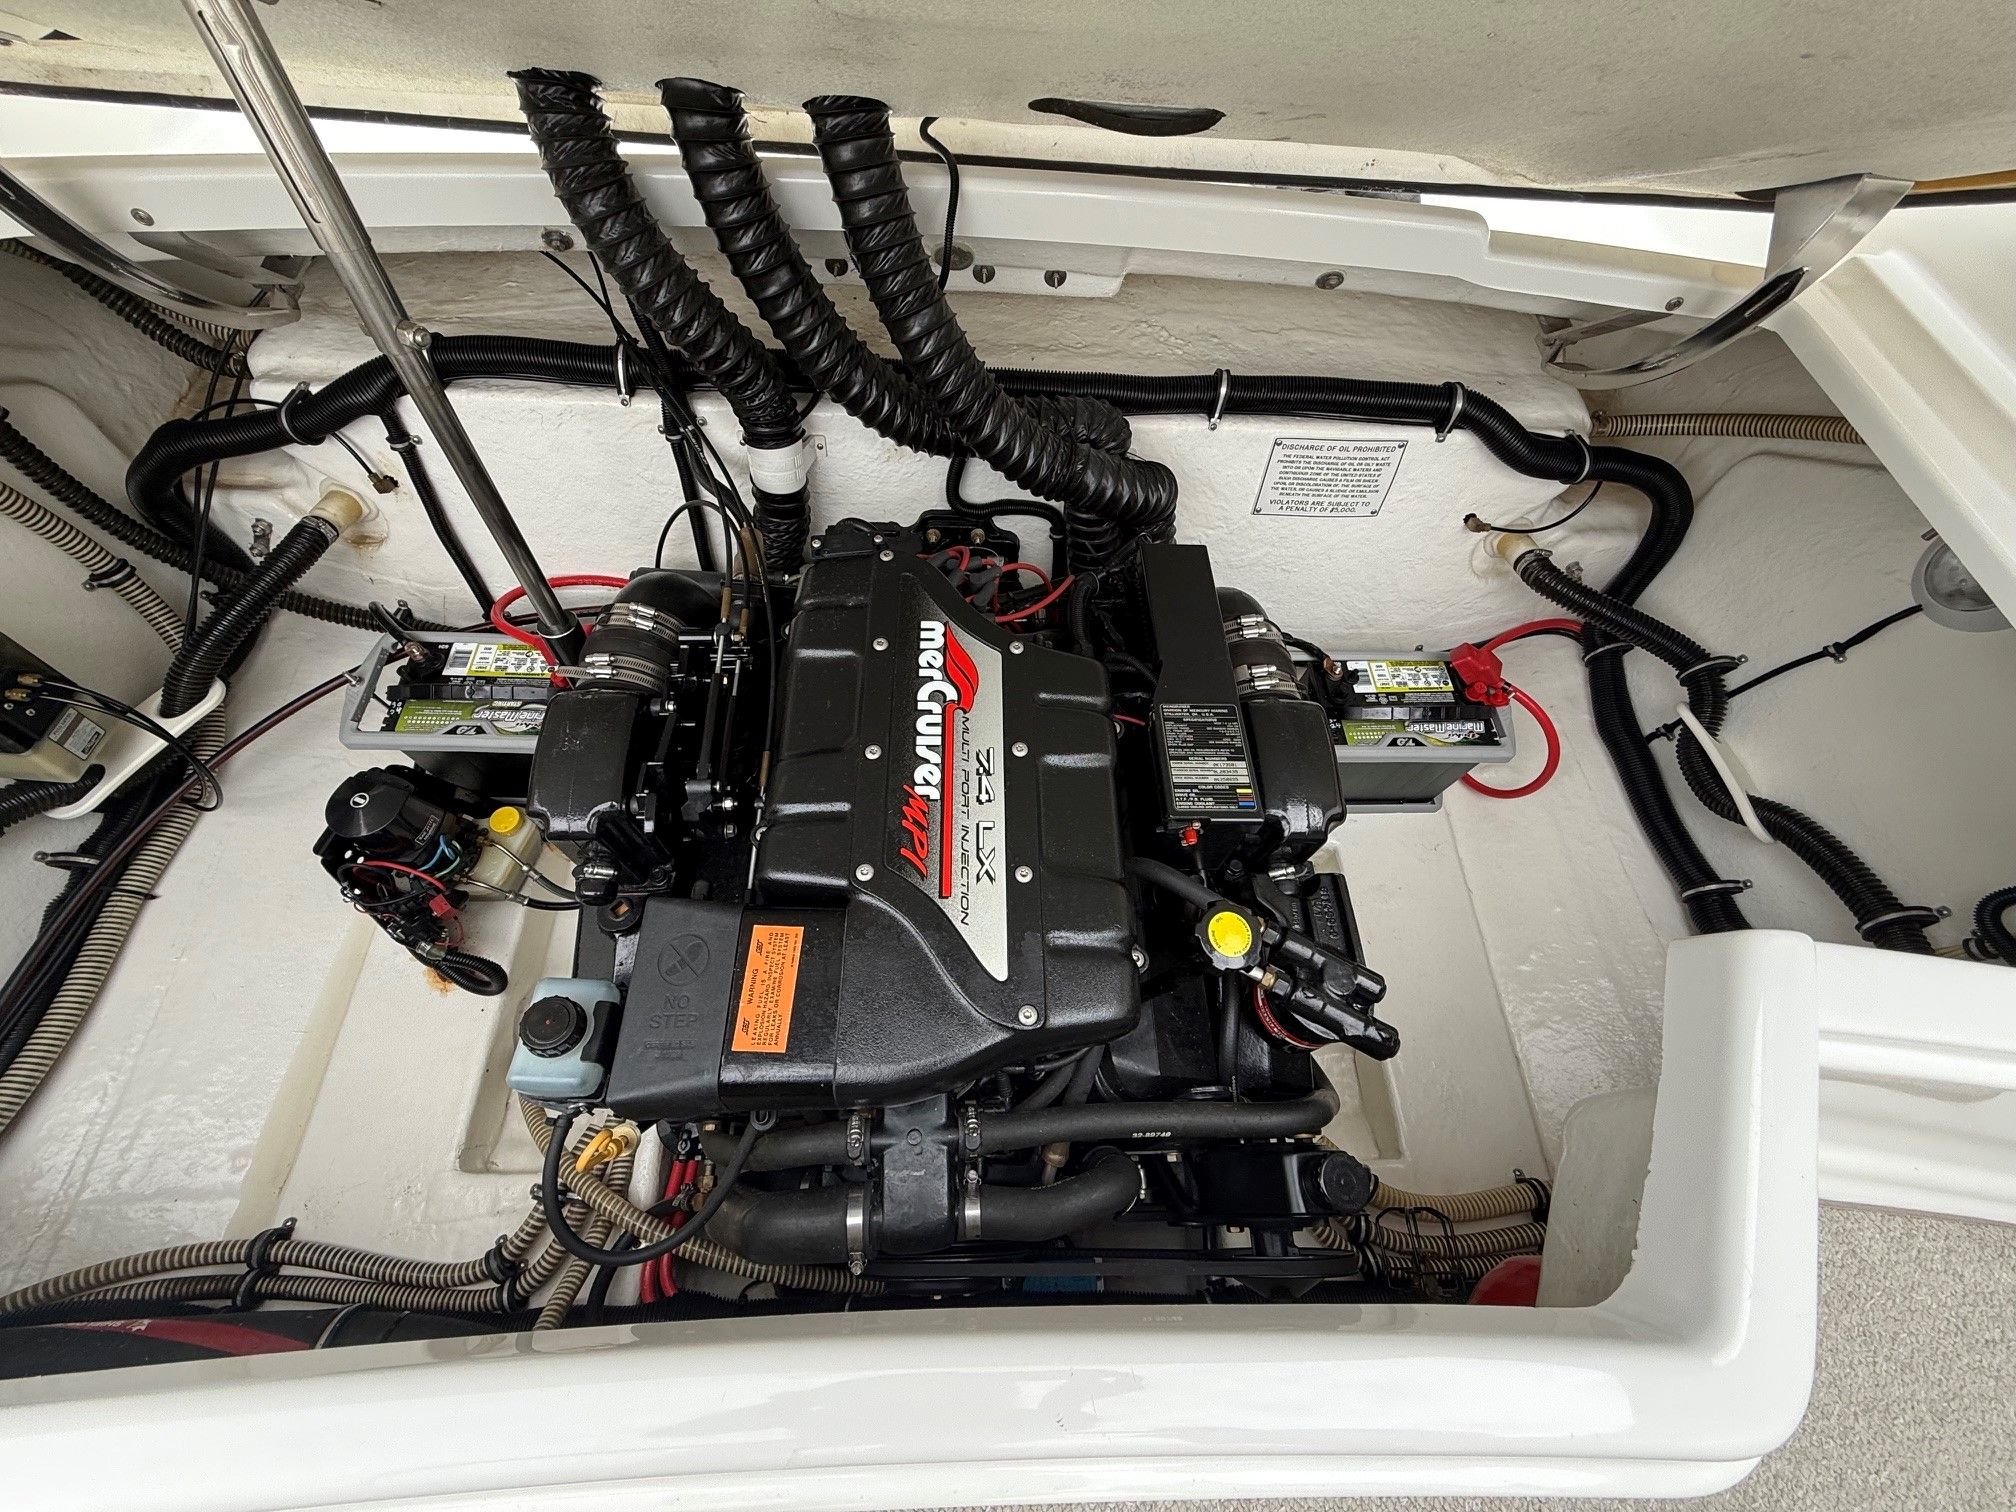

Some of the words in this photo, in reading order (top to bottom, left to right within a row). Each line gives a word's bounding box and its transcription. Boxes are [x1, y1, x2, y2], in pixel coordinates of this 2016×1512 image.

[1406, 721, 1484, 732] MarineMaster
[900, 784, 929, 880] MPI
[976, 820, 996, 885] LX
[961, 824, 969, 926] INJECTION
[747, 968, 759, 1005] WARNING
[776, 961, 786, 998] CORROSION
[664, 994, 690, 1009] NO
[756, 1009, 767, 1046] EXPLOSION
[767, 956, 776, 982] INSPECT
[774, 999, 779, 1008] OR
[650, 1012, 699, 1028] STEP
[751, 1014, 760, 1046] LEAKING
